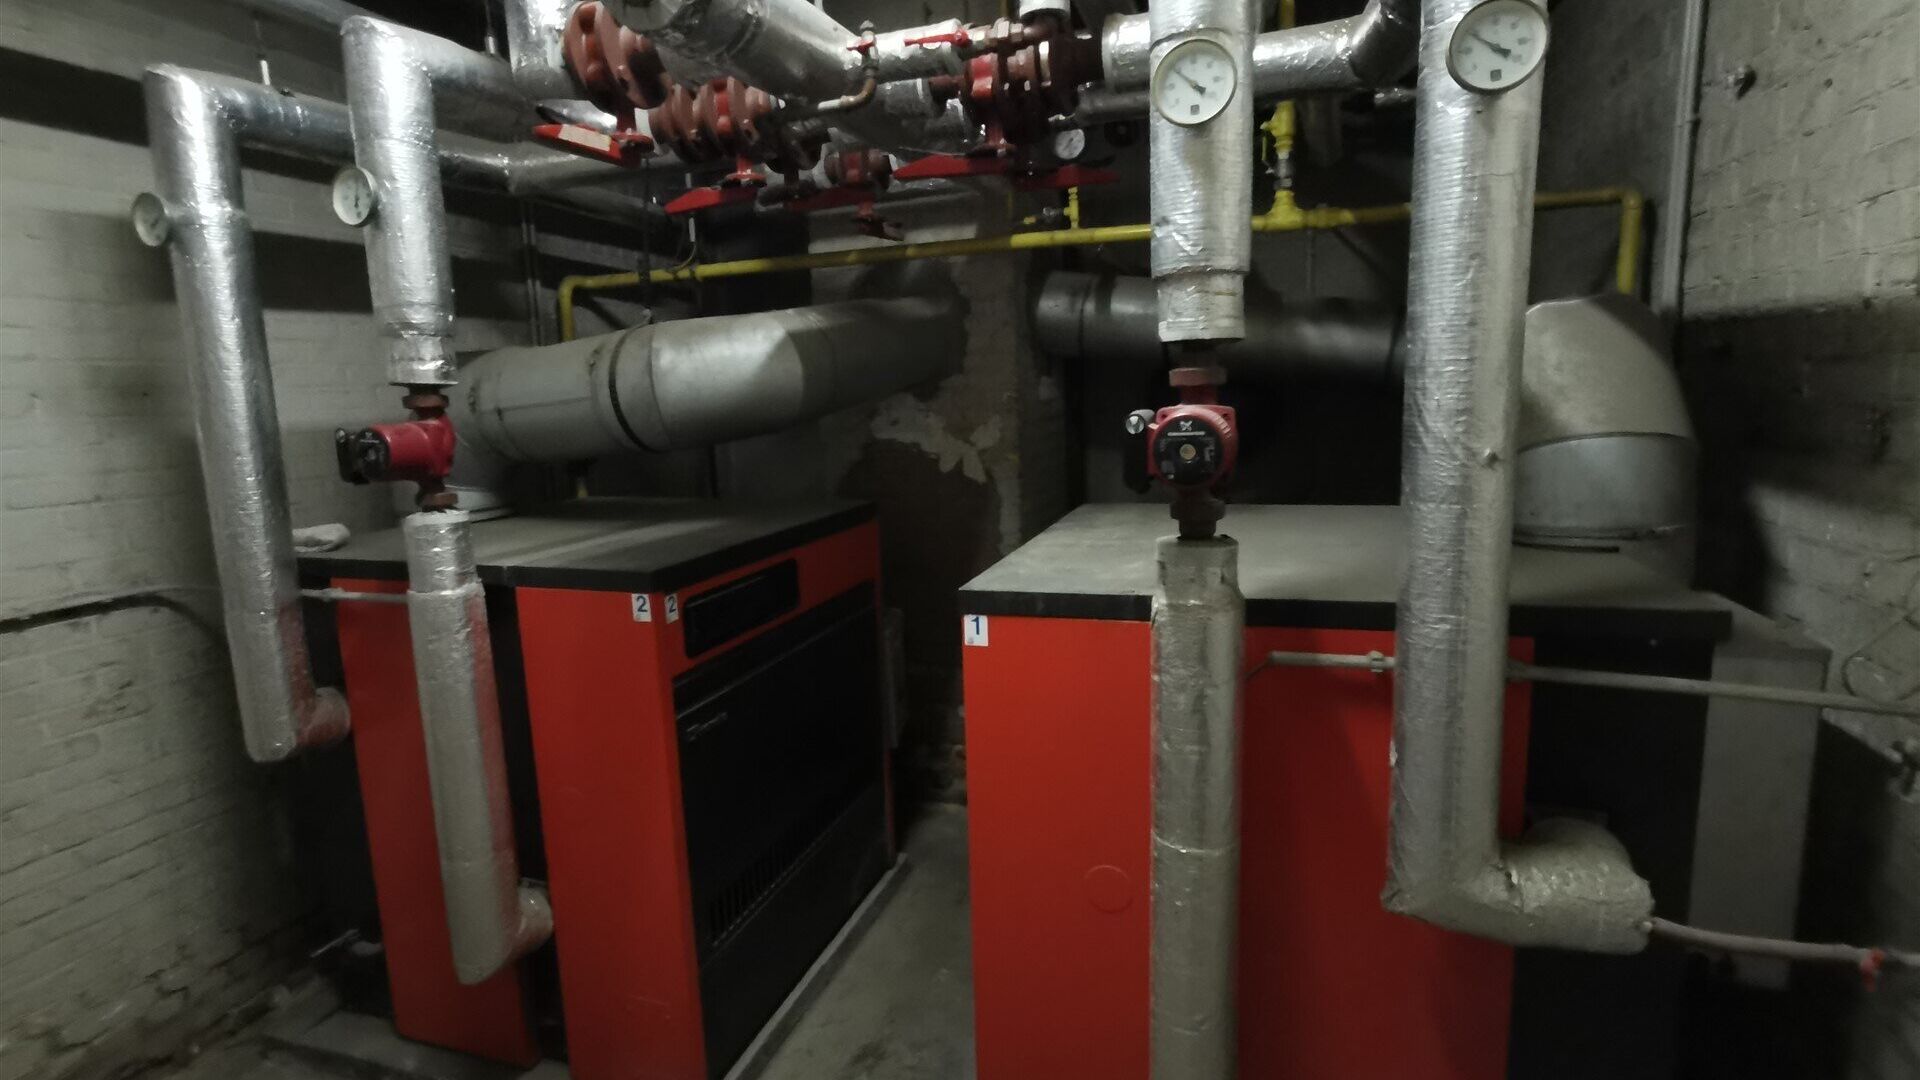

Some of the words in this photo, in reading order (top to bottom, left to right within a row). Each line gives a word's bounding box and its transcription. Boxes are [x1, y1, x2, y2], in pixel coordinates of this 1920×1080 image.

[636, 595, 648, 612] 2
[668, 595, 677, 613] 2
[971, 616, 980, 635] 1
